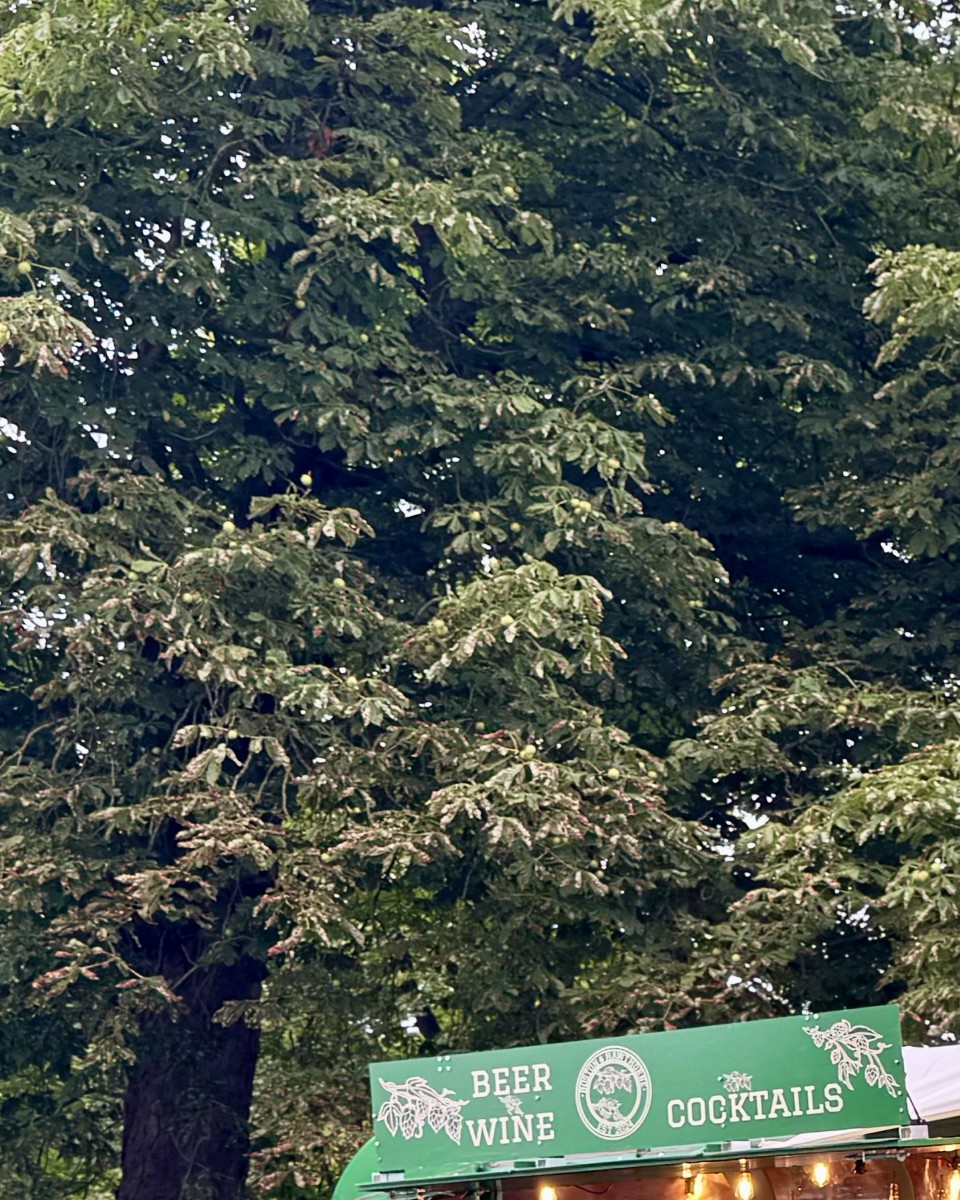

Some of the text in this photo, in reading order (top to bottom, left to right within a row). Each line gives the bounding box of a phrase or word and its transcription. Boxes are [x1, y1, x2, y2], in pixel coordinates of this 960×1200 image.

[471, 1063, 553, 1099] BEER
[667, 1083, 844, 1129] COCKTAILS
[467, 1112, 554, 1147] WINE
